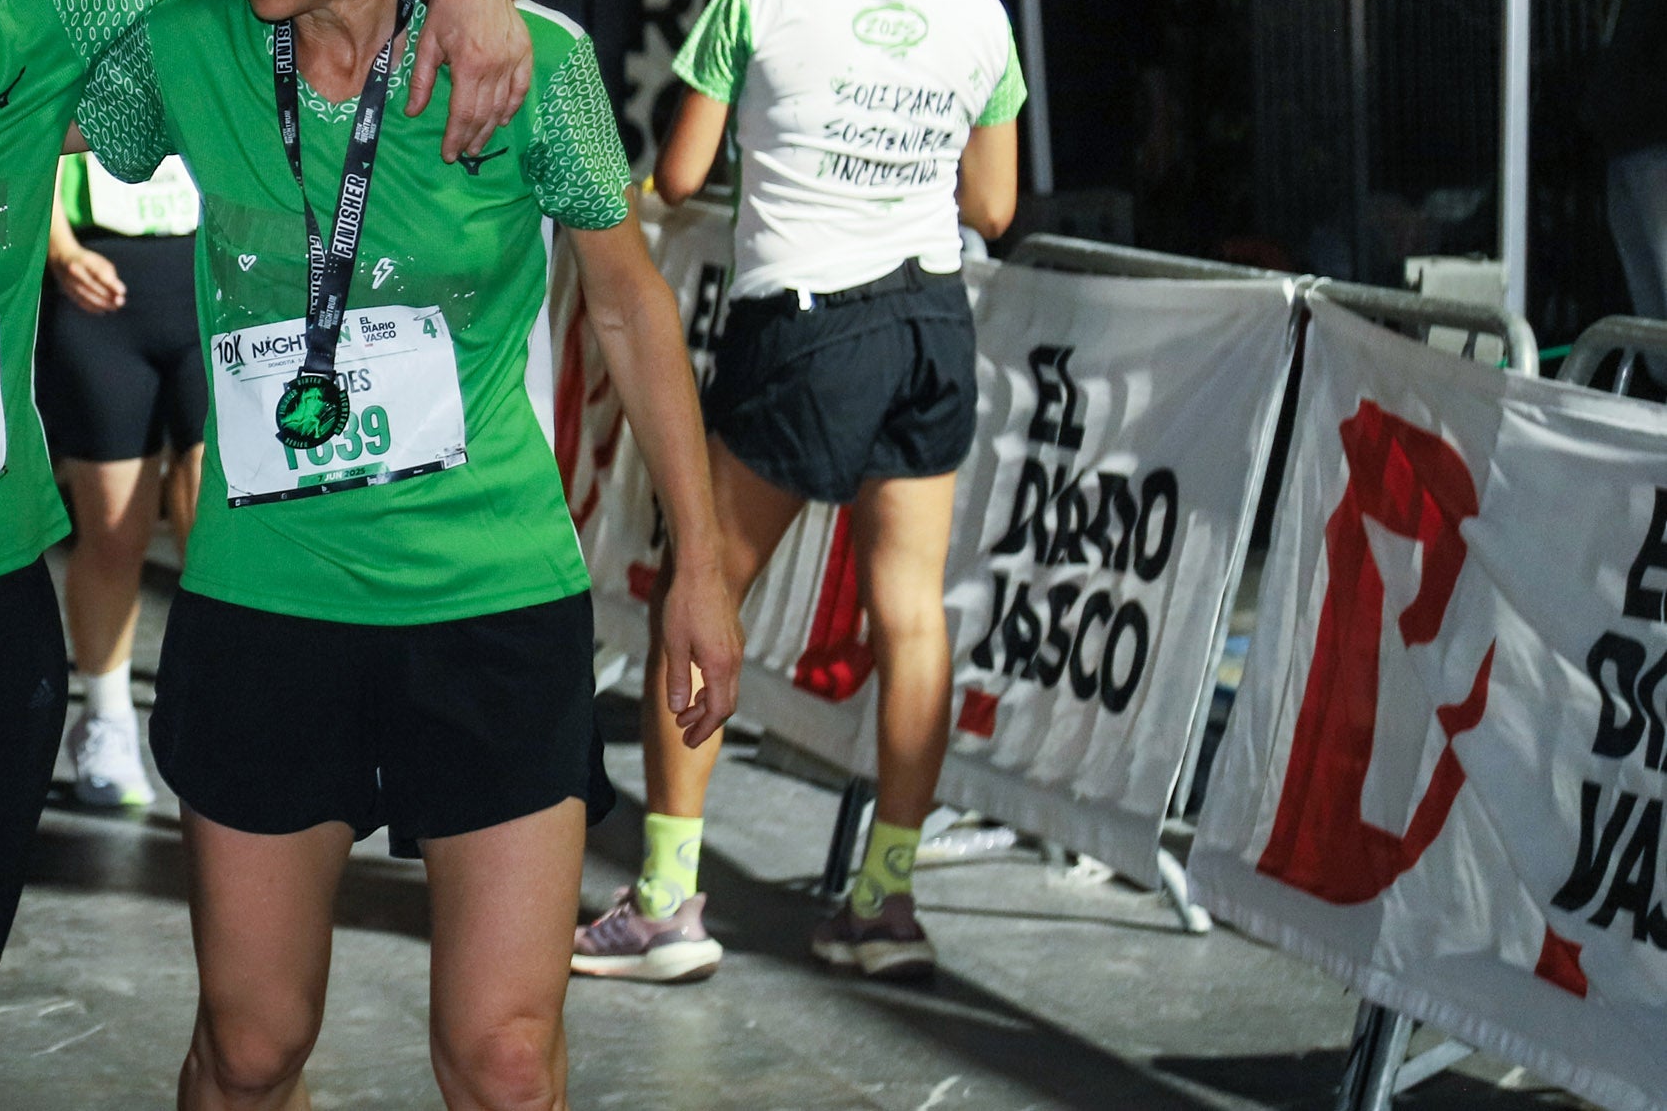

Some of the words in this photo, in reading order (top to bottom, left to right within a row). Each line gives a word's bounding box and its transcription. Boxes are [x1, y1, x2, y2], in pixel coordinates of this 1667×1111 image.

[332, 173, 367, 259] FINISHER
[359, 316, 371, 324] EL
[361, 321, 395, 334] DIARIO
[423, 318, 437, 339] 4
[364, 330, 396, 343] VASCO
[1029, 345, 1085, 450] EL
[324, 472, 343, 482] JUN
[344, 468, 366, 477] 2025
[1622, 486, 1667, 622] E
